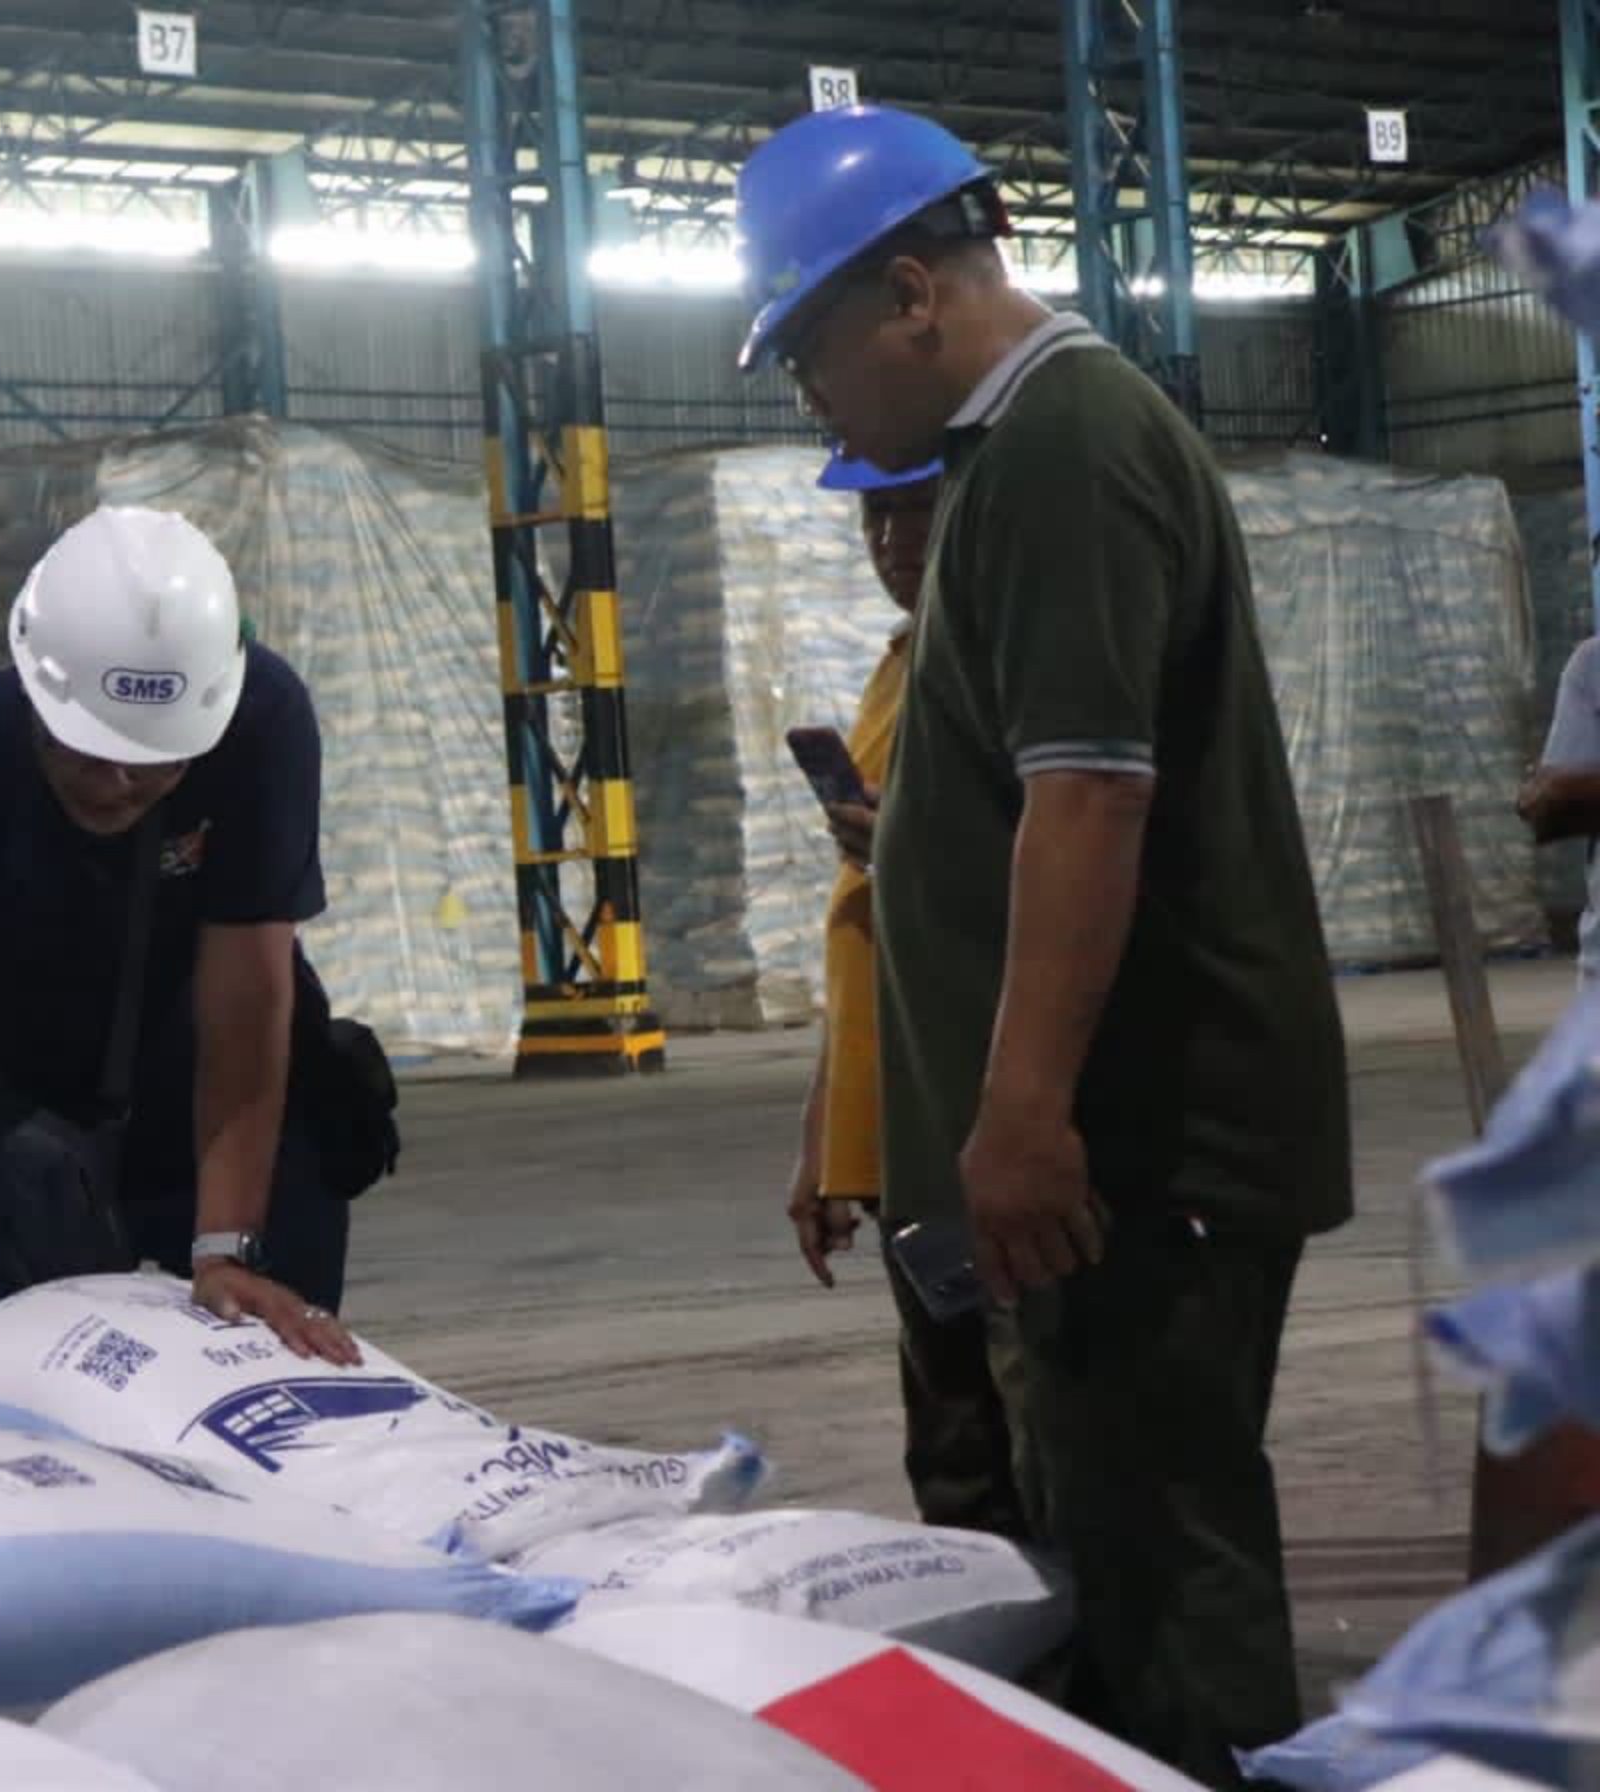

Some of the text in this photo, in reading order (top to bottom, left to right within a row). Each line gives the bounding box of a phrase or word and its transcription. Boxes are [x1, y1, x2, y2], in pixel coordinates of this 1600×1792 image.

[148, 23, 188, 64] B7
[819, 77, 852, 108] B8
[1375, 120, 1402, 152] B9
[114, 675, 176, 700] SMS
